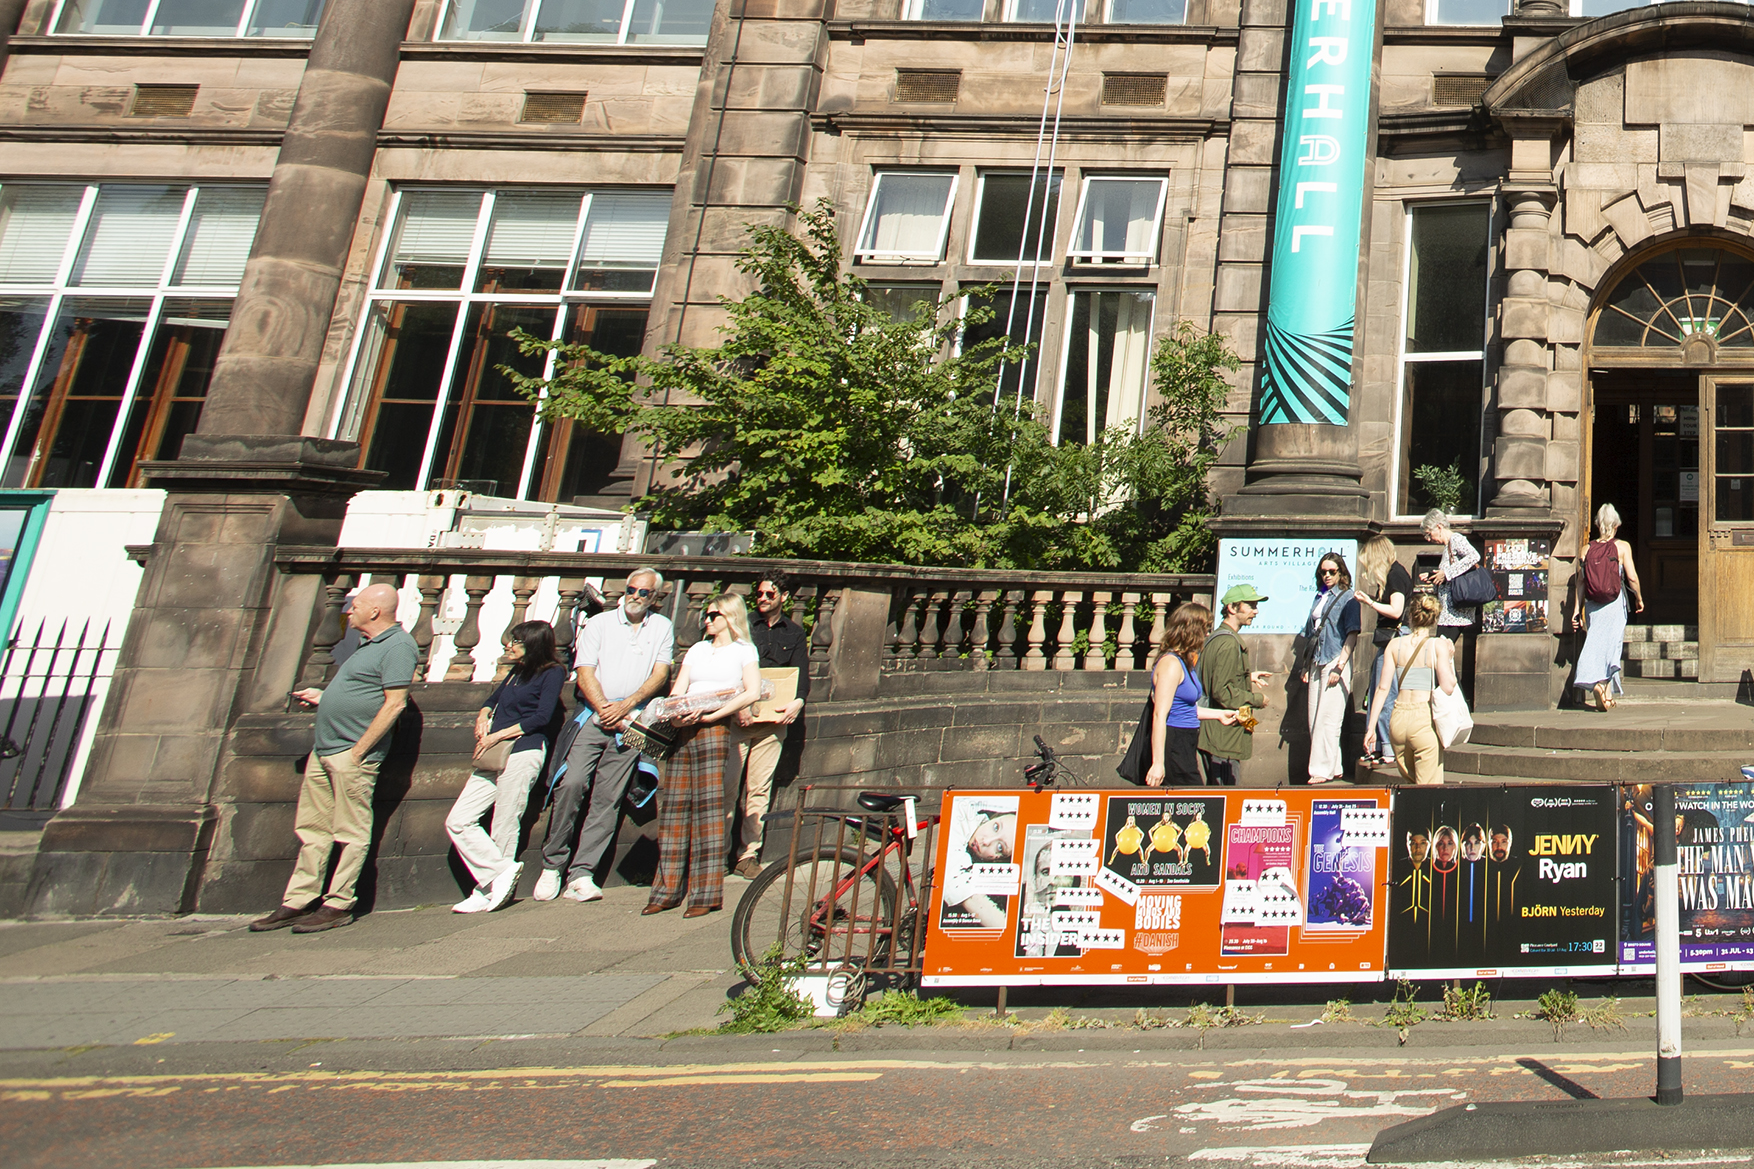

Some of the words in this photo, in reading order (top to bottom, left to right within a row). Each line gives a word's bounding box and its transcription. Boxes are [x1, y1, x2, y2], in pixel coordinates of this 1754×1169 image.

[1230, 546, 1347, 558] SUMMERHALL
[1128, 803, 1161, 815] WOMEN
[1164, 803, 1174, 815] IN
[1176, 803, 1205, 815] SOCKS
[1679, 802, 1709, 810] WATCH
[1722, 801, 1738, 809] THE
[1231, 828, 1291, 843] CHAMPIONS
[1693, 828, 1724, 843] JAMES
[1314, 844, 1324, 853] THE
[1313, 852, 1372, 872] GENESIS
[1676, 845, 1704, 875] THE
[1711, 844, 1745, 874] MAN
[1130, 863, 1150, 876] AND
[1153, 863, 1192, 875] SANDALS
[1539, 858, 1587, 884] Ryan
[1680, 876, 1718, 911] WAS
[1137, 895, 1182, 908] MOVING
[1138, 908, 1162, 916] MINDS
[1163, 907, 1181, 918] AND
[1521, 904, 1557, 917] BJÖRN
[1560, 906, 1605, 917] Yesterday
[1021, 918, 1051, 931] THE
[1135, 916, 1180, 929] BODIES
[1020, 933, 1079, 946] INSIDER
[1134, 932, 1179, 948] #DANISH
[1569, 942, 1592, 951] 17:30
